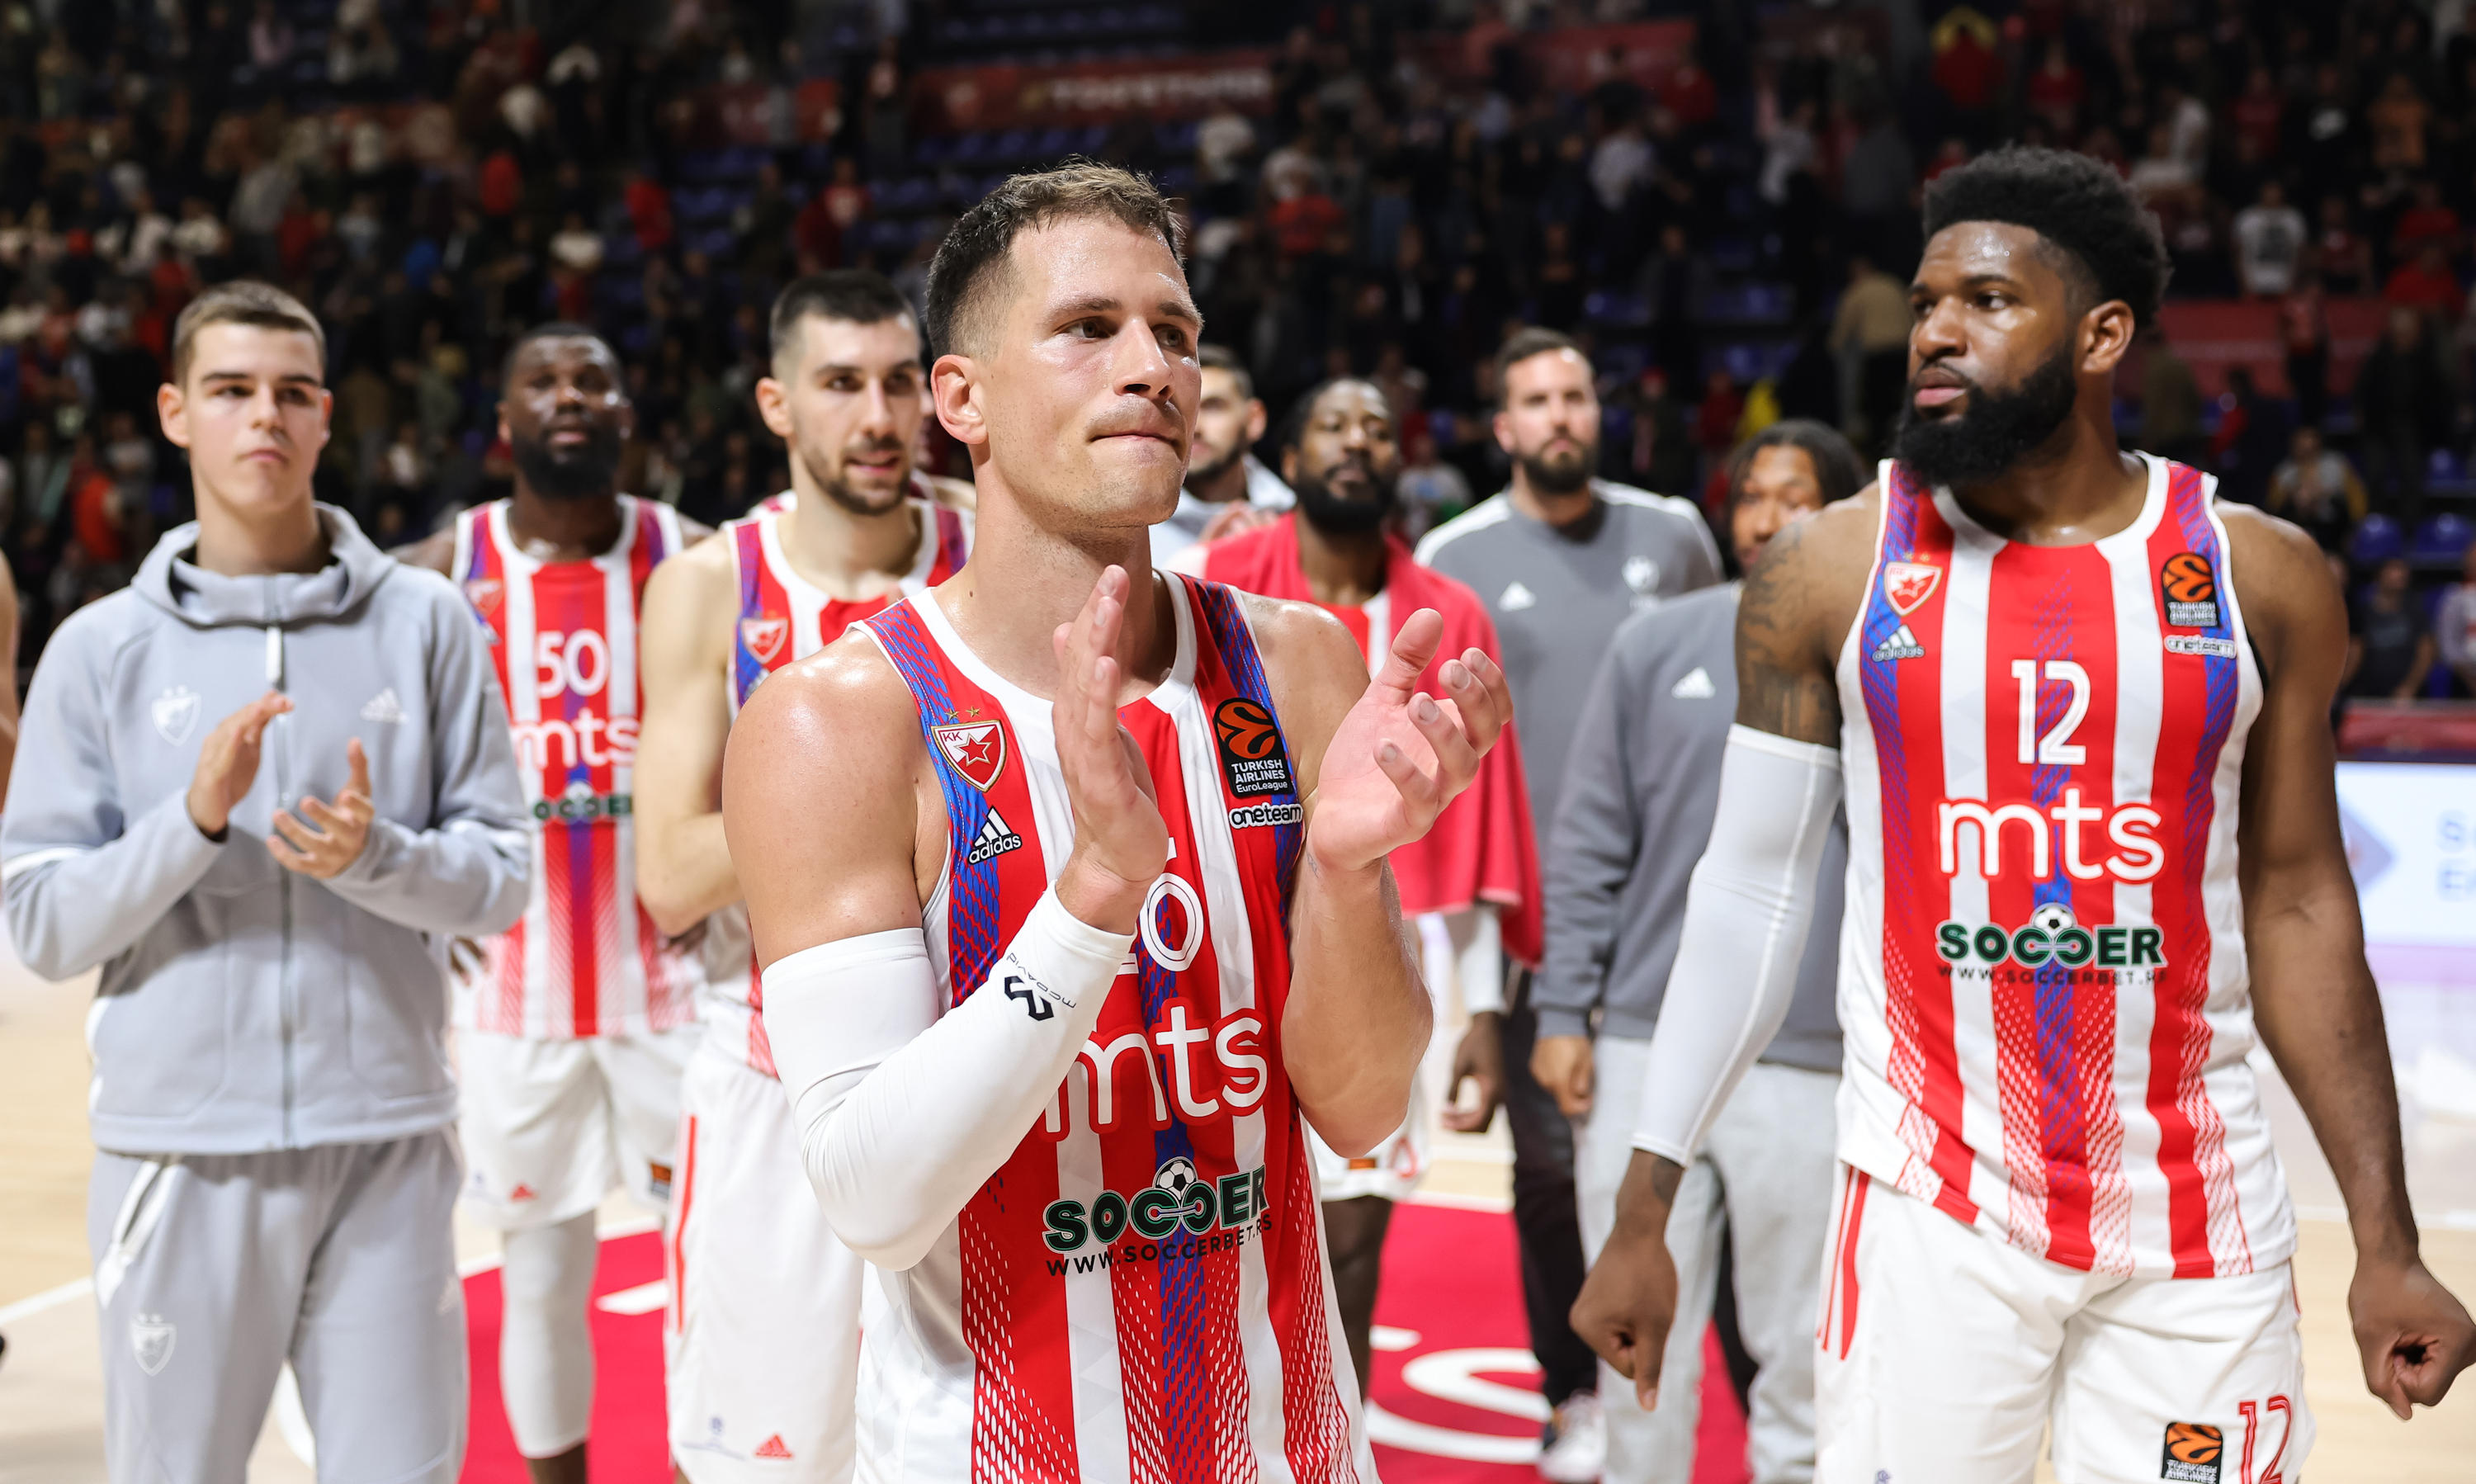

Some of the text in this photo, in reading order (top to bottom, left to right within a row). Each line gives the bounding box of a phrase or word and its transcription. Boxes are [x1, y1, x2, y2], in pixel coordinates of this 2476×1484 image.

[538, 629, 609, 699] 50
[1873, 645, 1925, 661] adidas
[511, 708, 640, 770] mts
[942, 731, 963, 743] KK
[2011, 659, 2091, 765] 12
[1231, 759, 1283, 773] TURKISH
[1236, 769, 1286, 784] AIRLINES
[1236, 781, 1288, 793] EuroLeague
[1231, 803, 1302, 826] oneteam
[1938, 788, 2166, 881] mts
[969, 835, 1022, 864] adidas
[1936, 920, 2167, 968] SOCCER
[1045, 1005, 1268, 1134] mts
[1042, 1162, 1269, 1254] SOCCER
[1046, 1213, 1273, 1277] WWW.SOCCERBET.RS
[2238, 1395, 2293, 1484] 12
